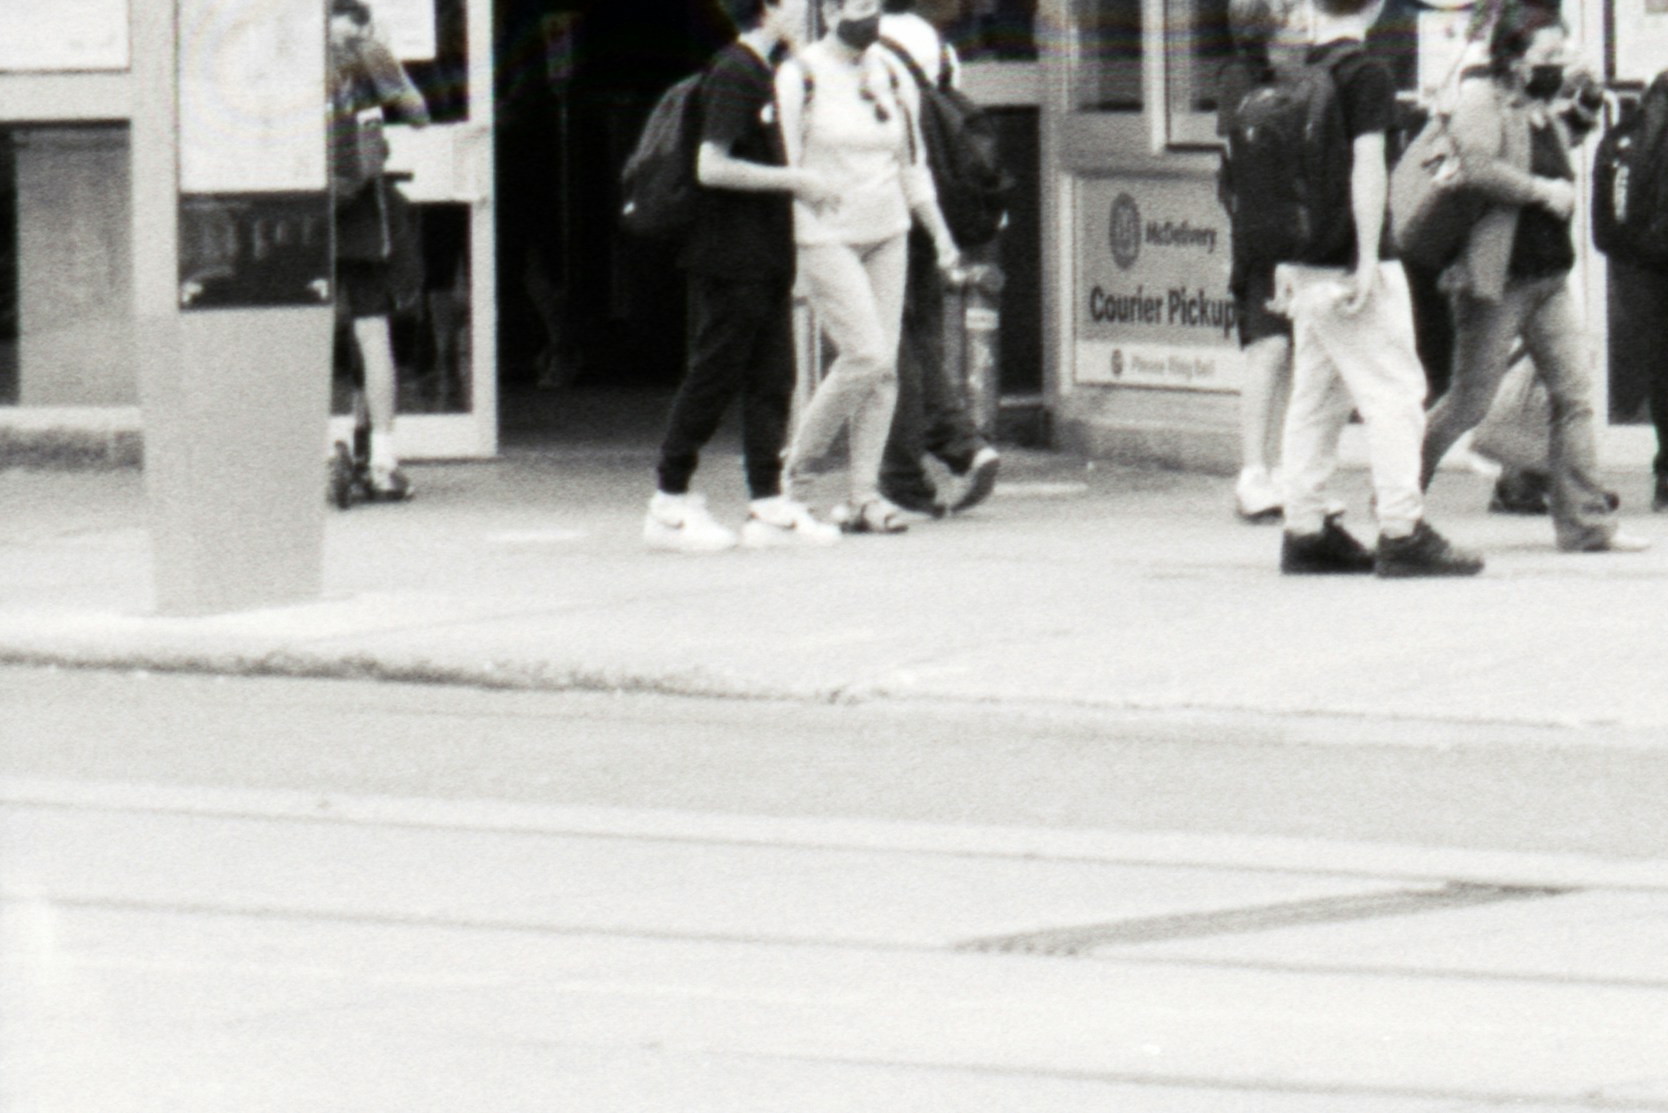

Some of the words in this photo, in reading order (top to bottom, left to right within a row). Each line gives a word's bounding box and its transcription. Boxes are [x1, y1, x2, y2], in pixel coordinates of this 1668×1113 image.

[1145, 219, 1218, 255] McDelivery
[1089, 285, 1164, 324] Courier
[1167, 286, 1237, 338] Pickup
